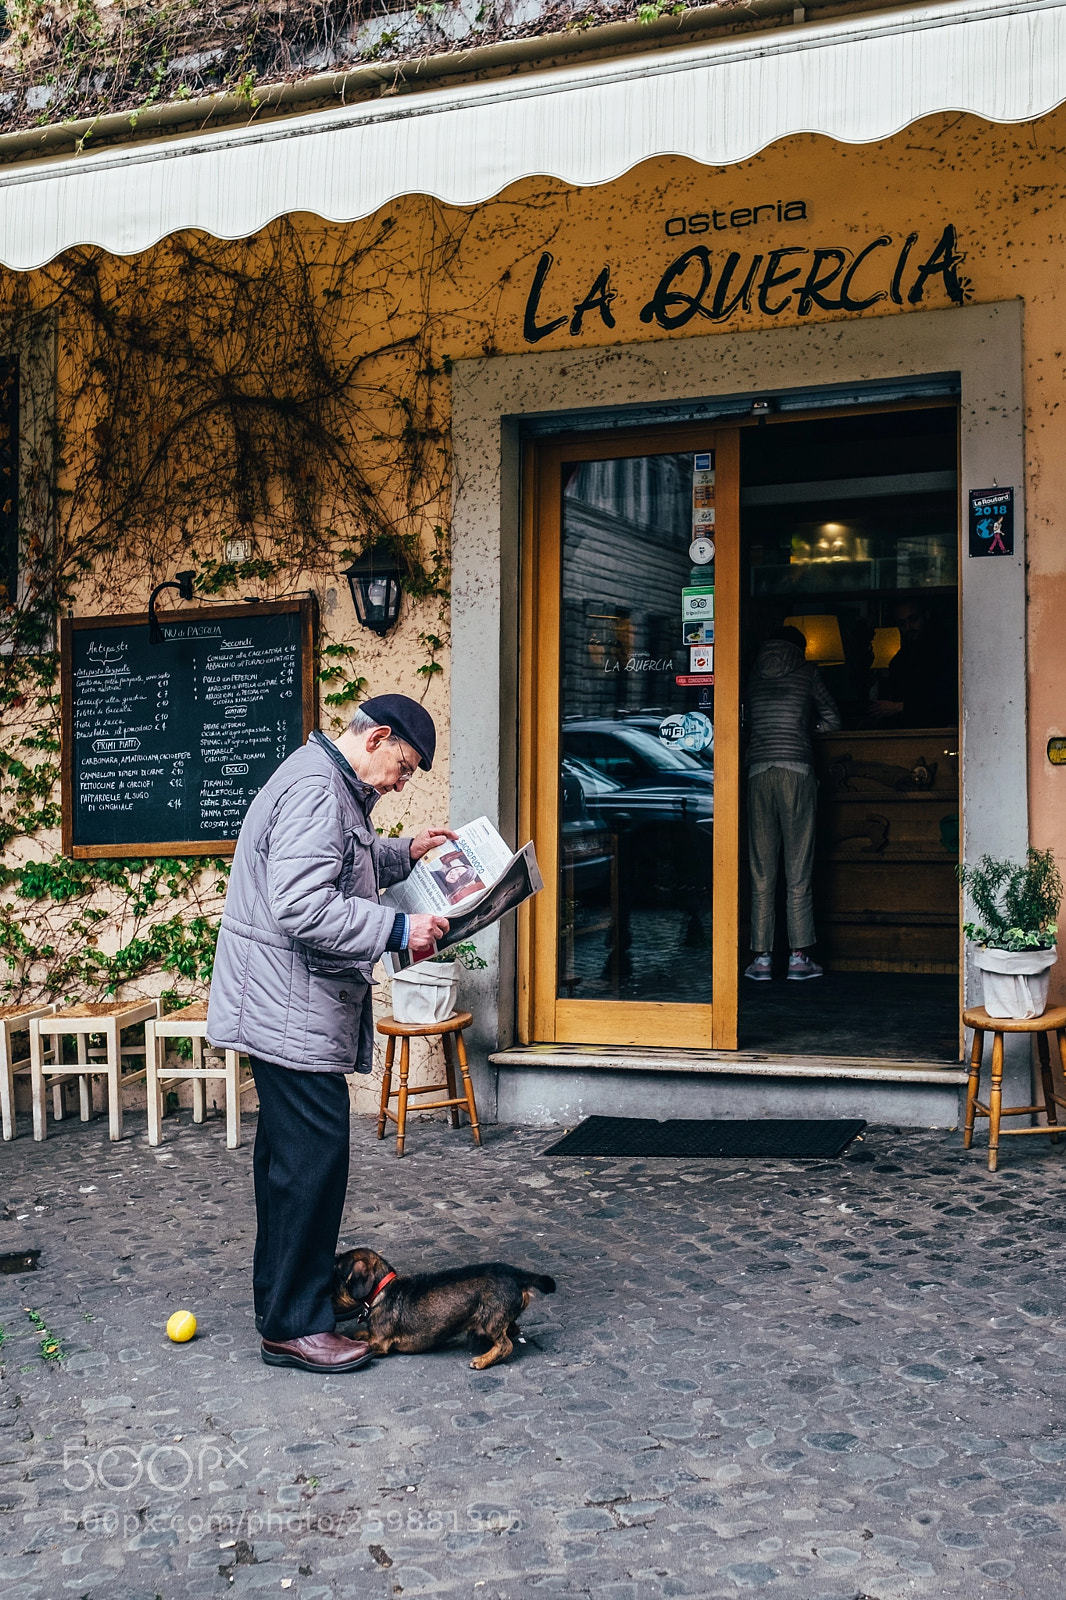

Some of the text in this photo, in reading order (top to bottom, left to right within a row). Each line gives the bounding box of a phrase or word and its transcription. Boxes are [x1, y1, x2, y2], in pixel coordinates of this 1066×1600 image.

[665, 200, 807, 237] osteria
[523, 223, 967, 344] LA QUERCIA
[982, 495, 1008, 505] Routard
[974, 506, 1007, 516] 2018
[187, 626, 222, 637] PASQUA
[221, 638, 252, 647] Secondi
[604, 658, 673, 672] LA QUERCIA
